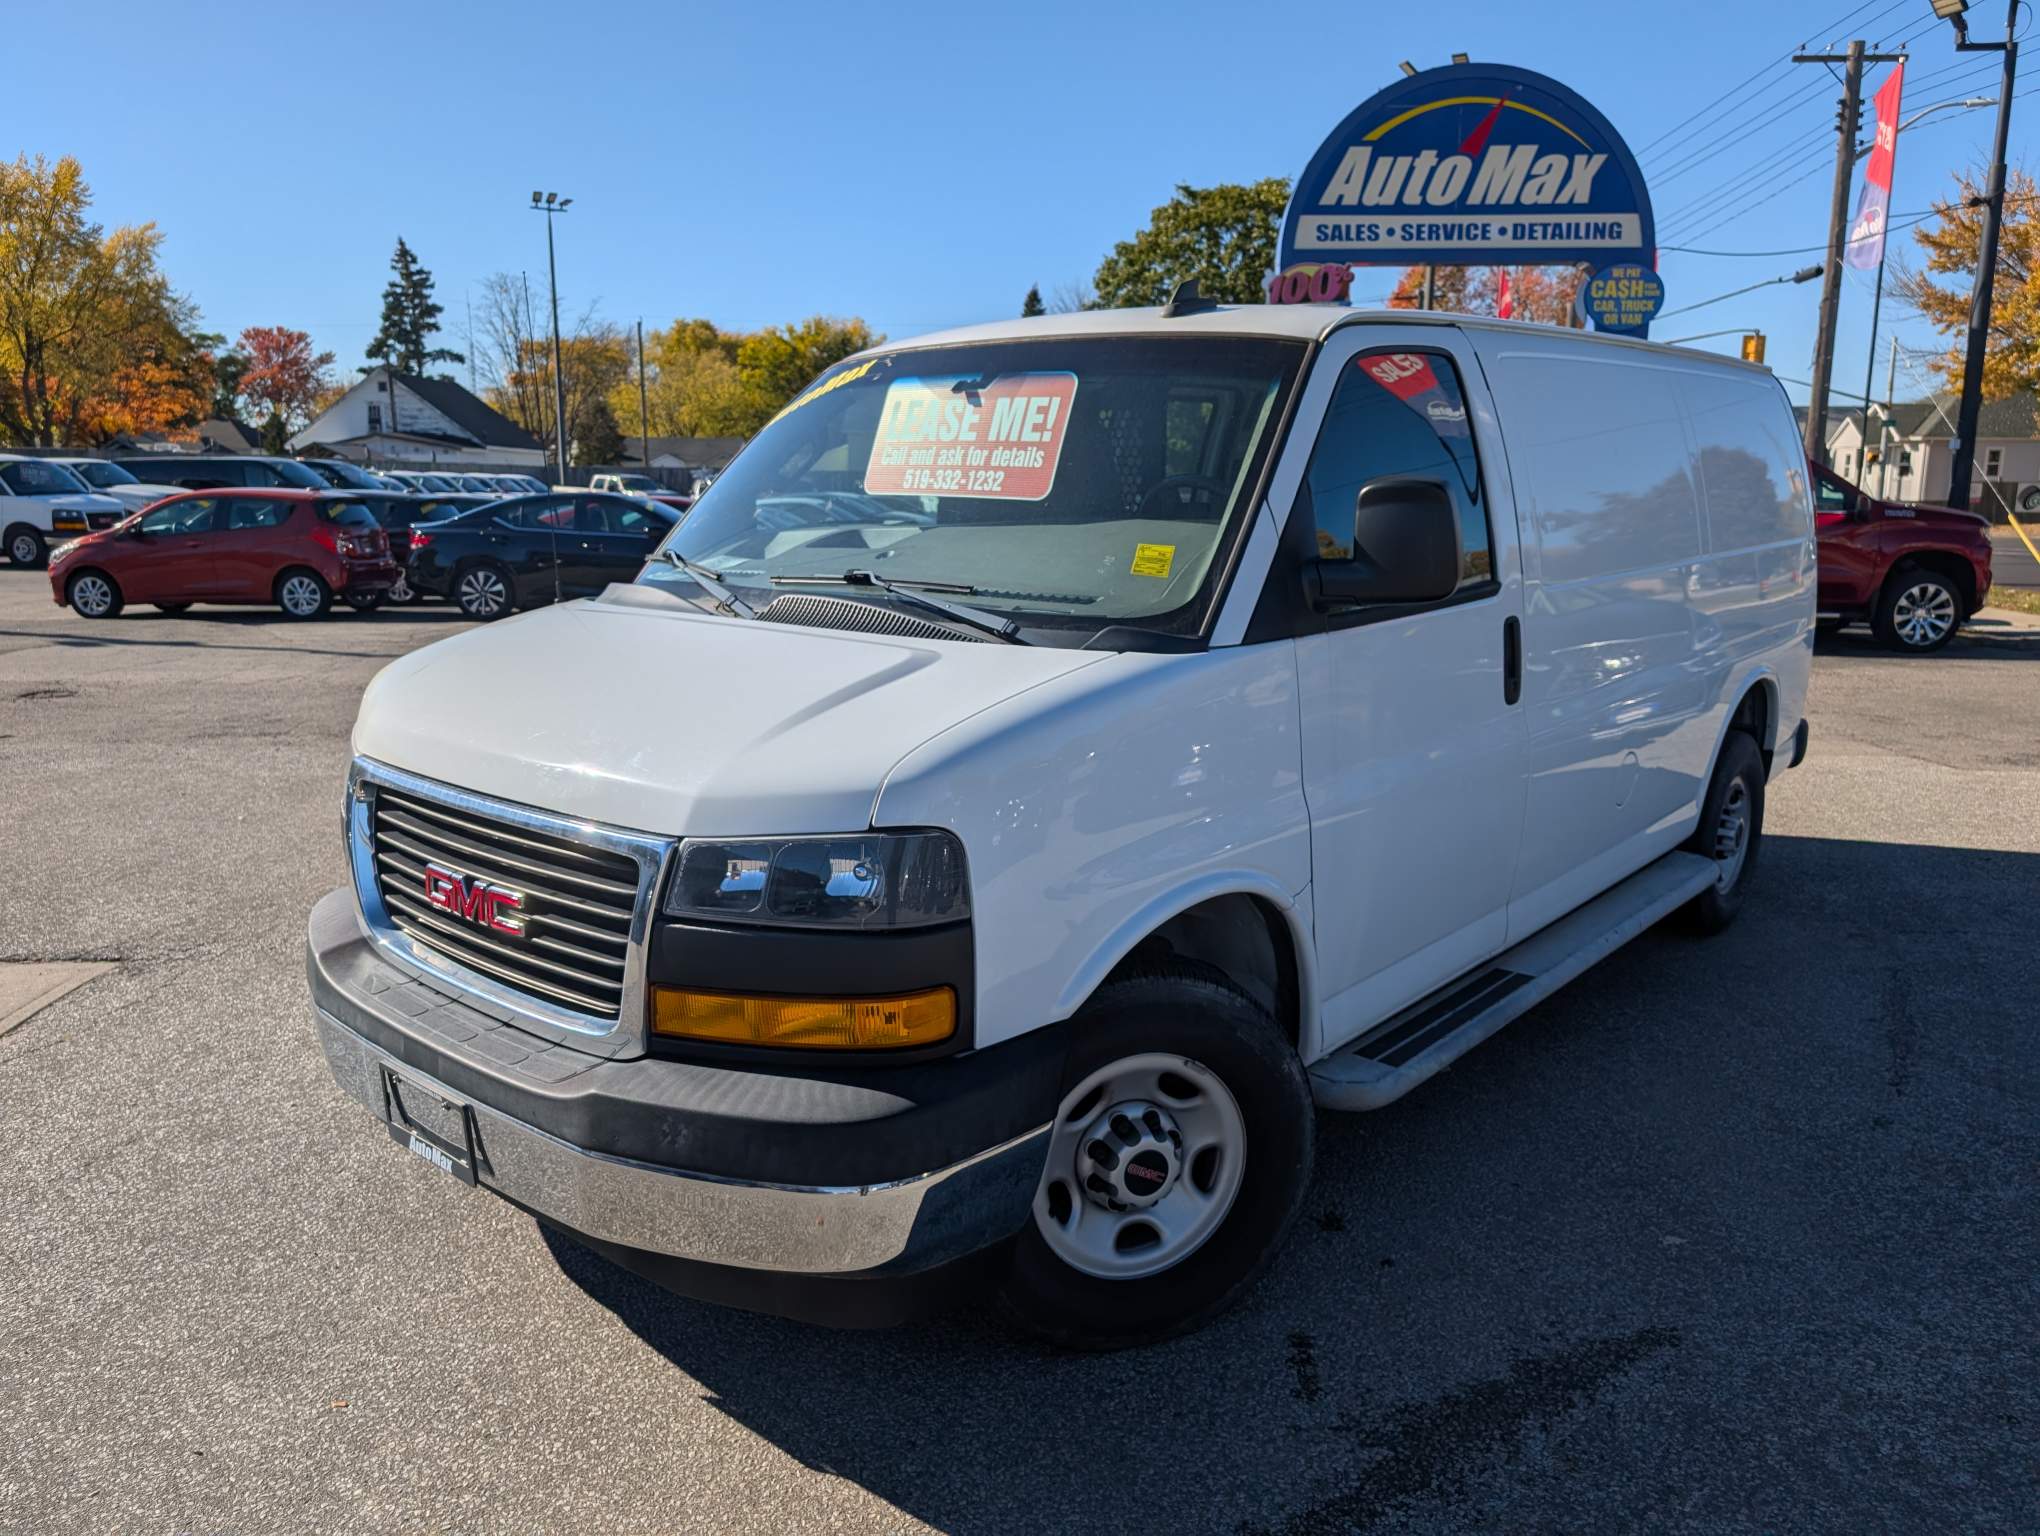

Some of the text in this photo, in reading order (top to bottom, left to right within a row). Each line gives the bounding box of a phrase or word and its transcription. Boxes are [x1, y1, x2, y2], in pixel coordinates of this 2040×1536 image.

[1318, 144, 1608, 206] AutoMax
[1315, 221, 1623, 242] SALES SERVICE DETAILING
[1590, 279, 1645, 298] CASH
[1620, 300, 1655, 313] TRUCK
[1603, 313, 1642, 326] OR VAN
[886, 396, 1061, 443] LEASE ME!
[881, 446, 1045, 468] Call and ask for details
[902, 469, 1005, 491] 519-332-1232
[425, 862, 526, 938] GMC
[409, 1135, 453, 1172] AutoMax
[1127, 1162, 1167, 1184] GMC
